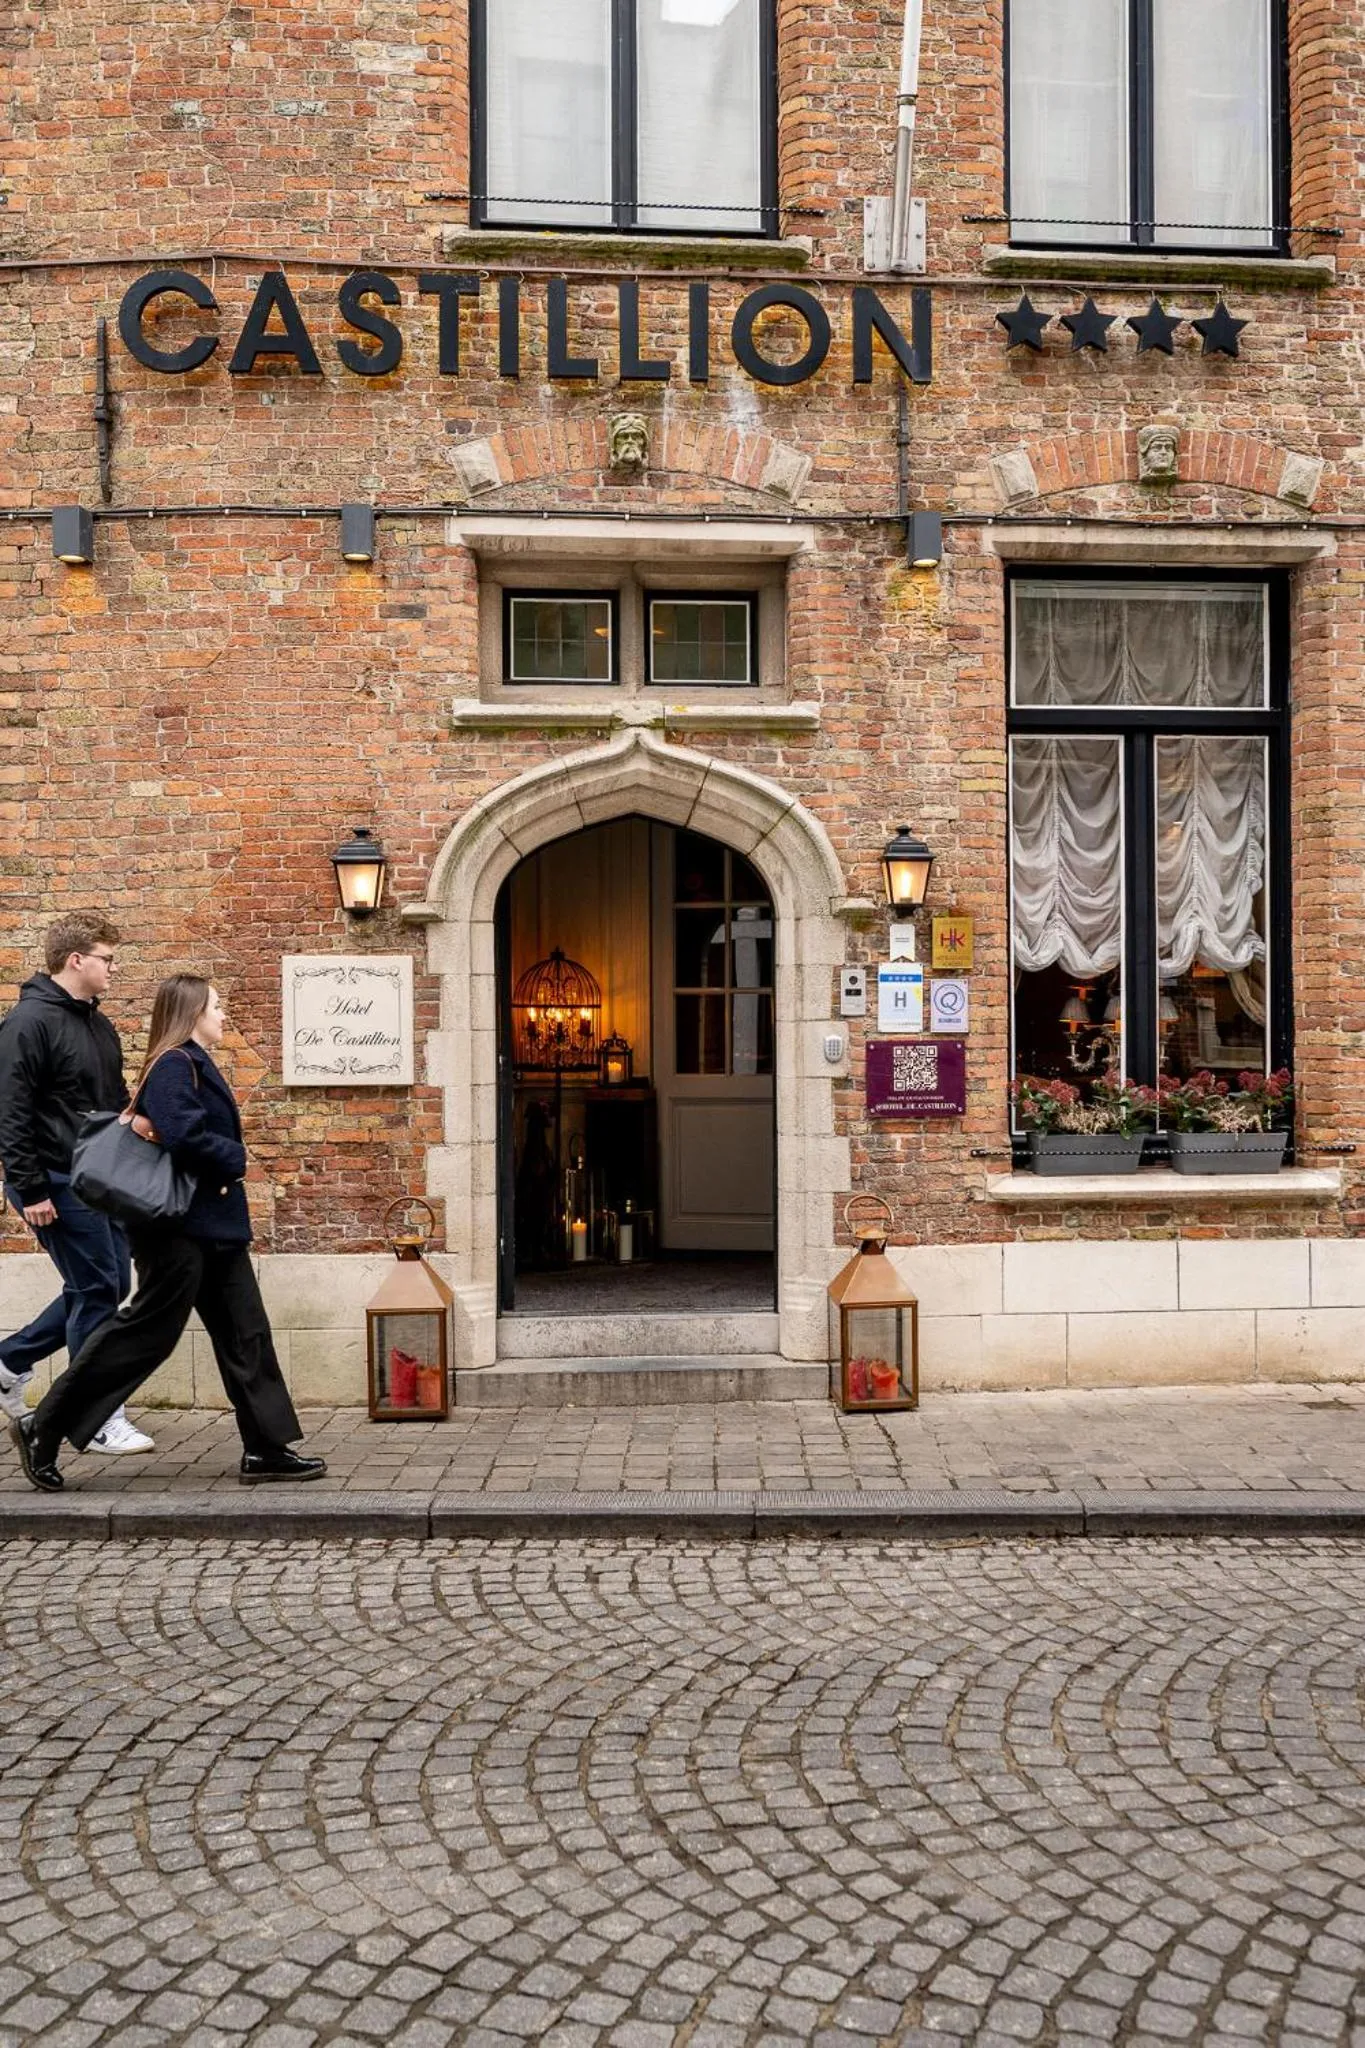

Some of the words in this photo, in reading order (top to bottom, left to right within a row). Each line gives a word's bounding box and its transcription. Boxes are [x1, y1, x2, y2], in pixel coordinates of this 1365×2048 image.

[118, 269, 932, 384] CASTILLION
[325, 995, 374, 1016] Hotel
[895, 991, 907, 1008] H
[940, 992, 958, 1011] Q
[294, 1027, 324, 1046] De
[328, 1026, 401, 1046] Castillion
